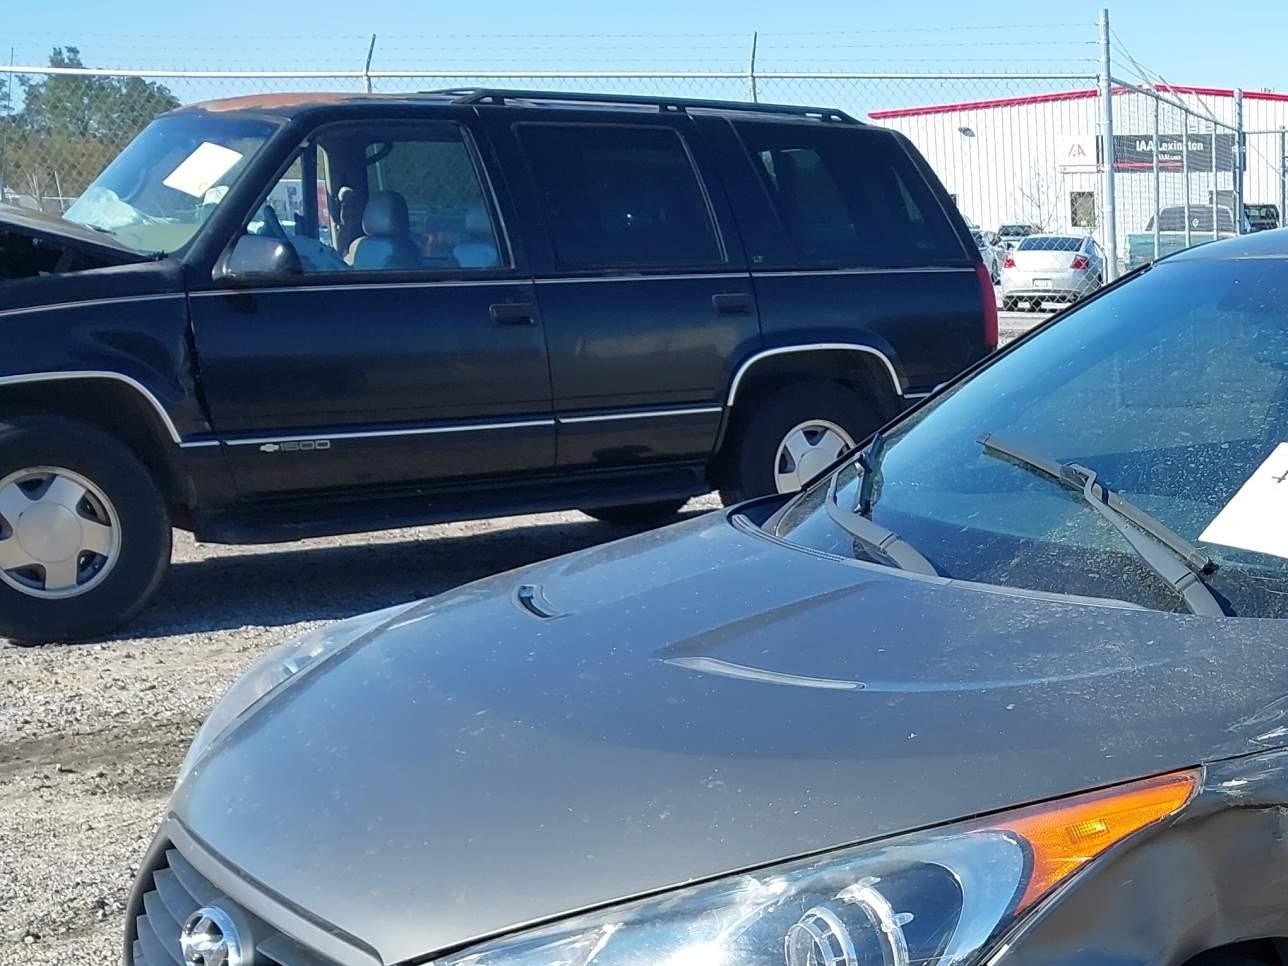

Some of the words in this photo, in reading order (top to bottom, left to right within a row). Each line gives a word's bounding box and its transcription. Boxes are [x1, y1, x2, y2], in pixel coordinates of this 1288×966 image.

[1136, 140, 1154, 151] IAA
[1158, 140, 1204, 151] Lexinton
[280, 440, 330, 451] 1500
